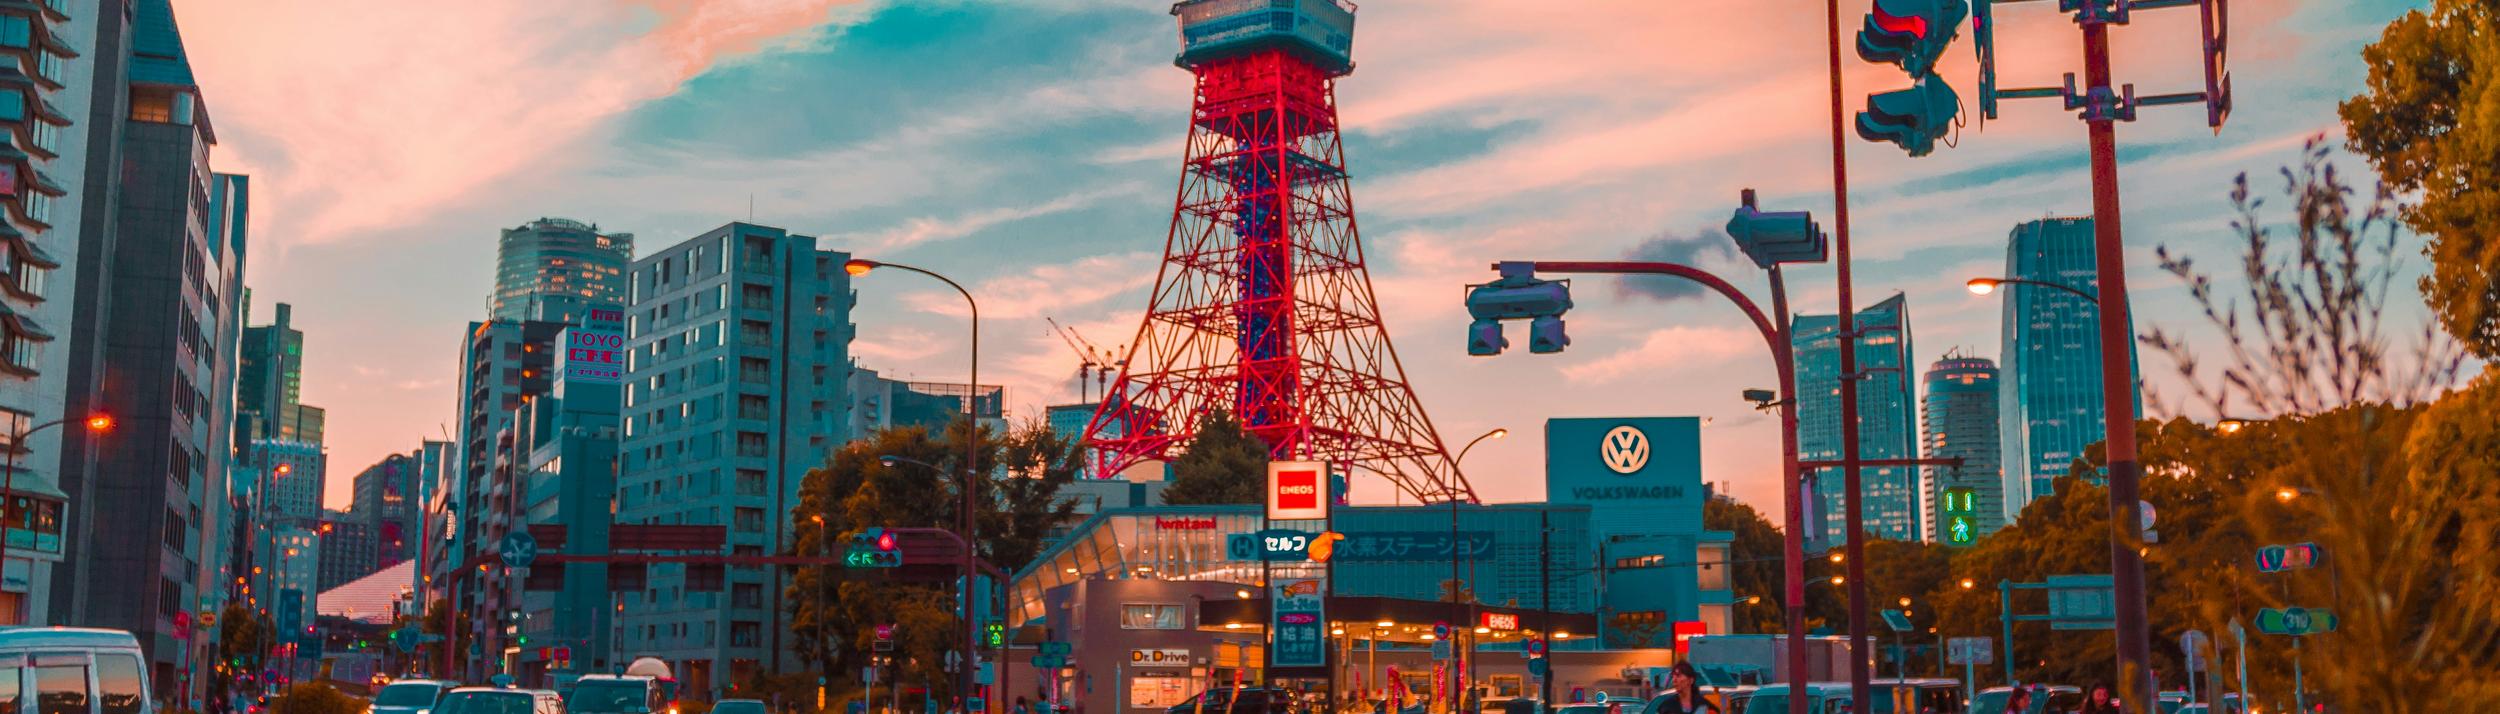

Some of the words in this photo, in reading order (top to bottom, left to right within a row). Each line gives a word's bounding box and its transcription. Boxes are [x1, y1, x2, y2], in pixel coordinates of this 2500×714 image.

[1279, 485, 1315, 495] ENEOS
[1572, 485, 1684, 500] VOLKSWAGEN
[1265, 536, 1306, 552] セルフ
[1335, 536, 1490, 557] 水素ステーション
[1489, 615, 1516, 630] ENEOS
[1131, 650, 1150, 662] Dr.
[1152, 650, 1189, 663] Drive
